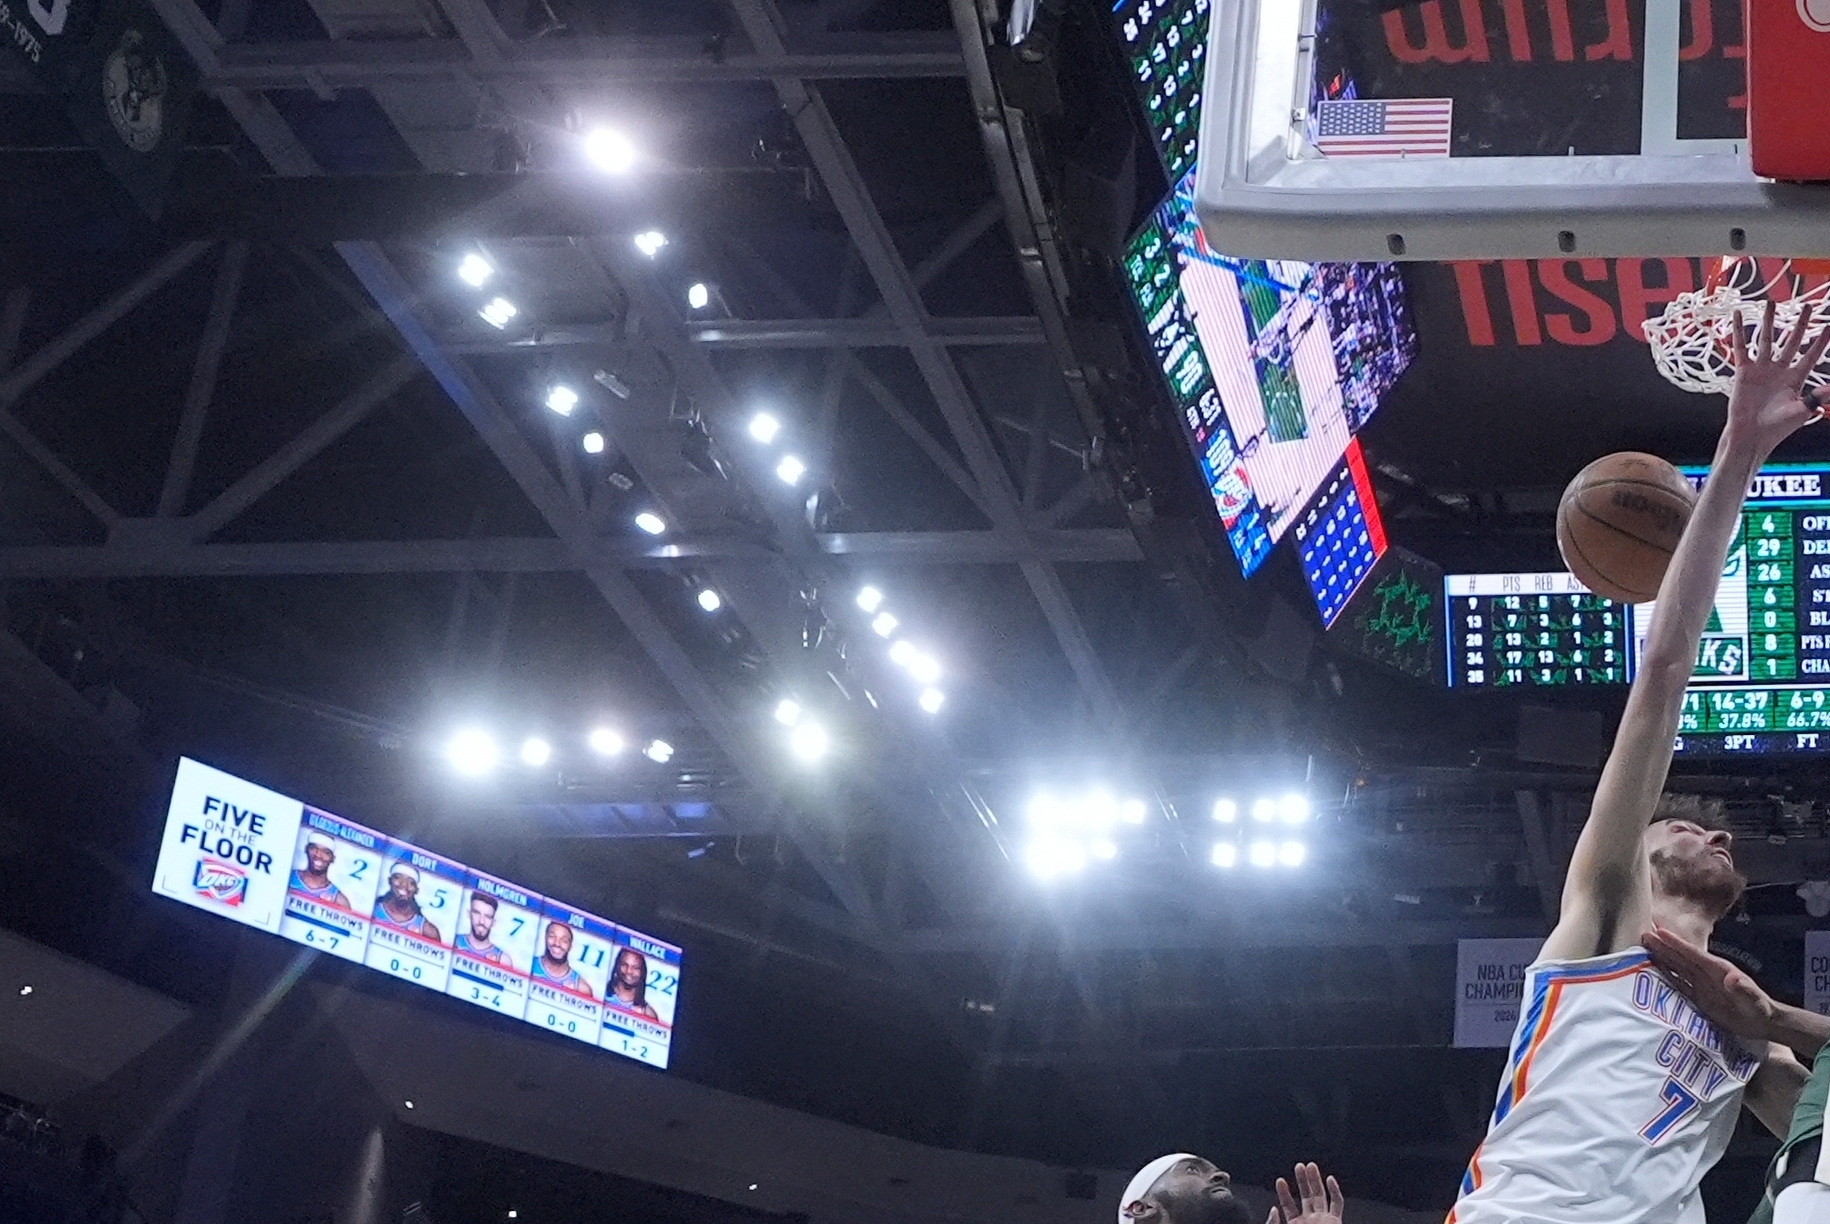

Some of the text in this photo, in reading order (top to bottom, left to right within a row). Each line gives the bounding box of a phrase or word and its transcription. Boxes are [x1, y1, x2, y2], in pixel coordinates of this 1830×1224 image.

[1762, 514, 1774, 533] 4
[1757, 539, 1780, 556] 29
[1758, 563, 1781, 581] 26
[1503, 576, 1553, 591] PTS REB
[1764, 588, 1776, 604] 6
[1764, 611, 1776, 628] 0
[1765, 634, 1777, 651] 8
[1801, 635, 1823, 649] PTS
[1766, 659, 1776, 675] 1
[1712, 692, 1768, 710] 14-37
[1790, 691, 1825, 709] 6-9
[1719, 713, 1766, 728] 37.8%
[1724, 735, 1755, 750] 3PT
[1796, 734, 1819, 748] FT
[203, 795, 267, 836] FIVE
[205, 819, 256, 845] ON THE
[180, 824, 273, 875] FLOOR
[349, 858, 368, 880] 2
[412, 853, 437, 871] DORT
[430, 889, 447, 908] 5
[478, 878, 528, 905] HOLMGREN
[289, 899, 363, 931] FREE THROWS
[568, 913, 585, 929] JOE
[509, 918, 525, 936] 7
[375, 928, 445, 960] FREE THROWS
[629, 937, 666, 960] WALLACE
[577, 943, 605, 968] 11
[1477, 964, 1505, 981] NBA
[646, 970, 677, 996] 22
[1655, 1029, 1728, 1102] CITY
[1638, 1075, 1699, 1146] 7
